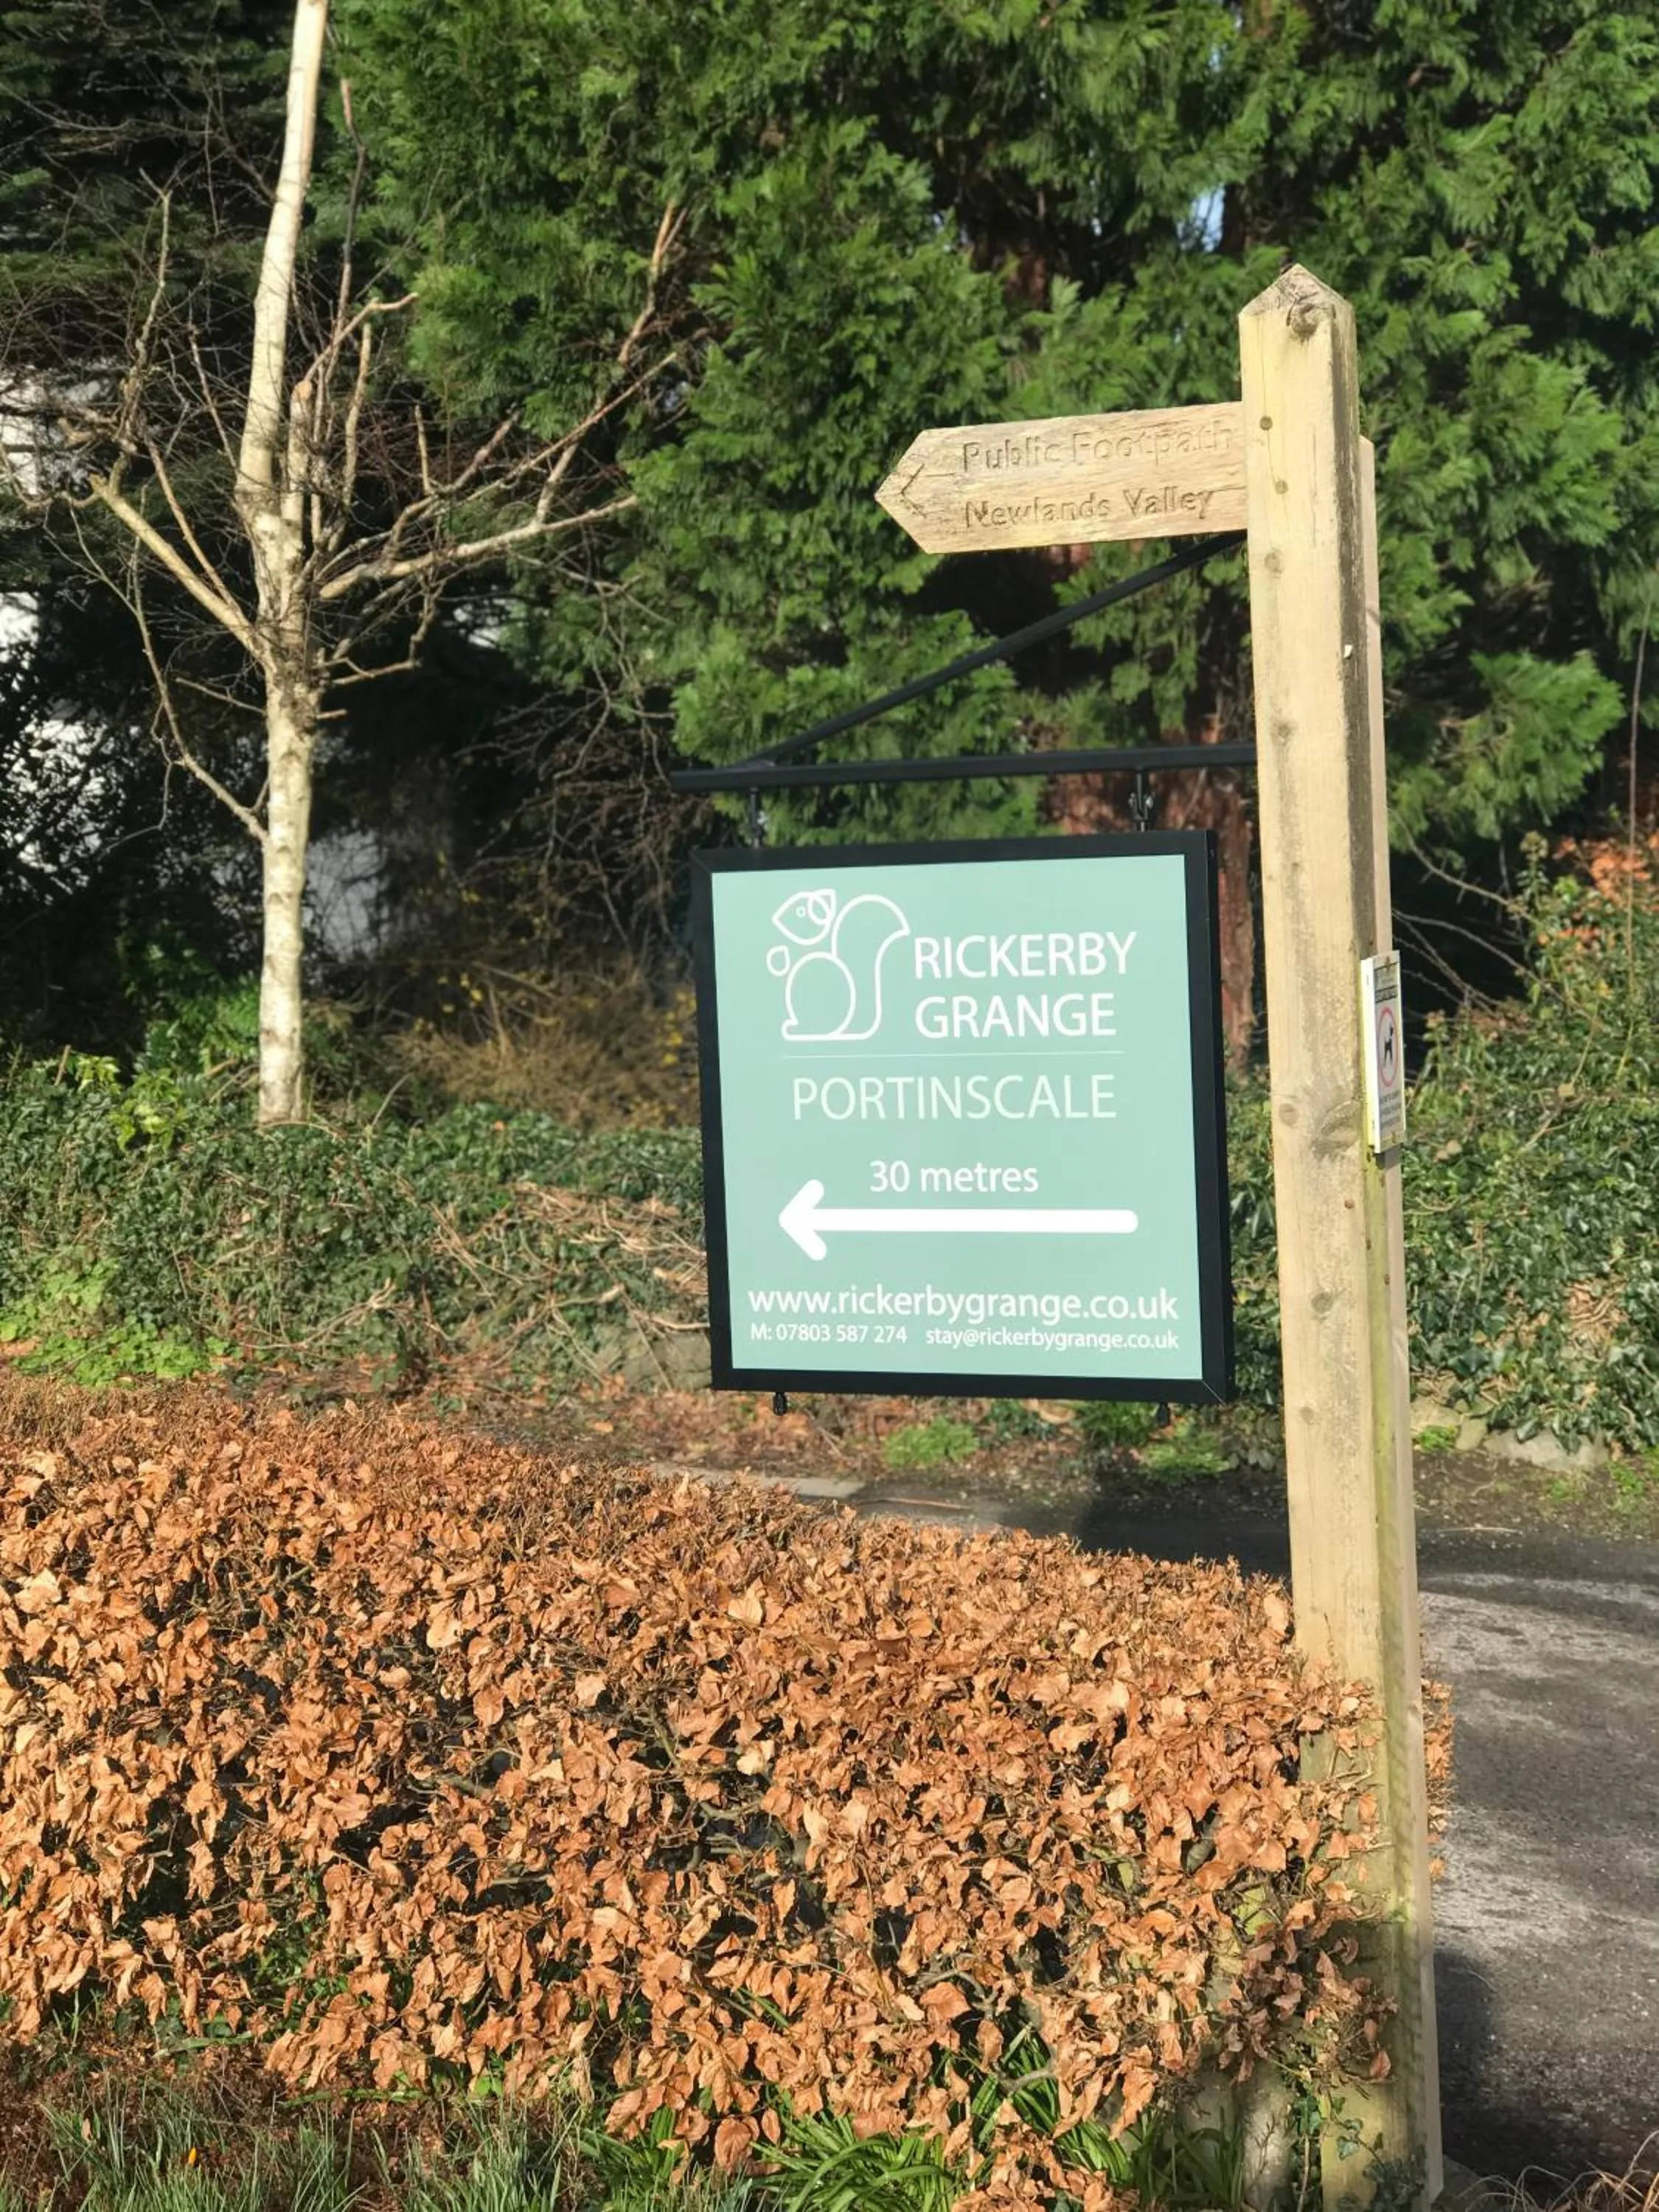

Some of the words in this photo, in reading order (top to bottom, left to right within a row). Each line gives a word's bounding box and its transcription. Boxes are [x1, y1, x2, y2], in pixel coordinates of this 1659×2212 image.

[962, 436, 1061, 472] Public
[1072, 420, 1232, 465] Footpath
[964, 493, 1110, 528] Newlands
[1122, 485, 1215, 519] Valley
[914, 931, 1138, 980] RICKERBY
[914, 992, 1117, 1039] GRANGE
[793, 1074, 1117, 1121] PORTINSCALE
[869, 1160, 911, 1193] 30
[920, 1161, 1039, 1193] metres
[748, 1284, 1179, 1325] www.rickerbygrange.co.uk
[750, 1323, 773, 1341] M:
[775, 1323, 832, 1342] 07803
[836, 1324, 869, 1343] 587
[873, 1325, 908, 1344] 274
[925, 1326, 1179, 1351] stay@rickerbygrange.co.uk
